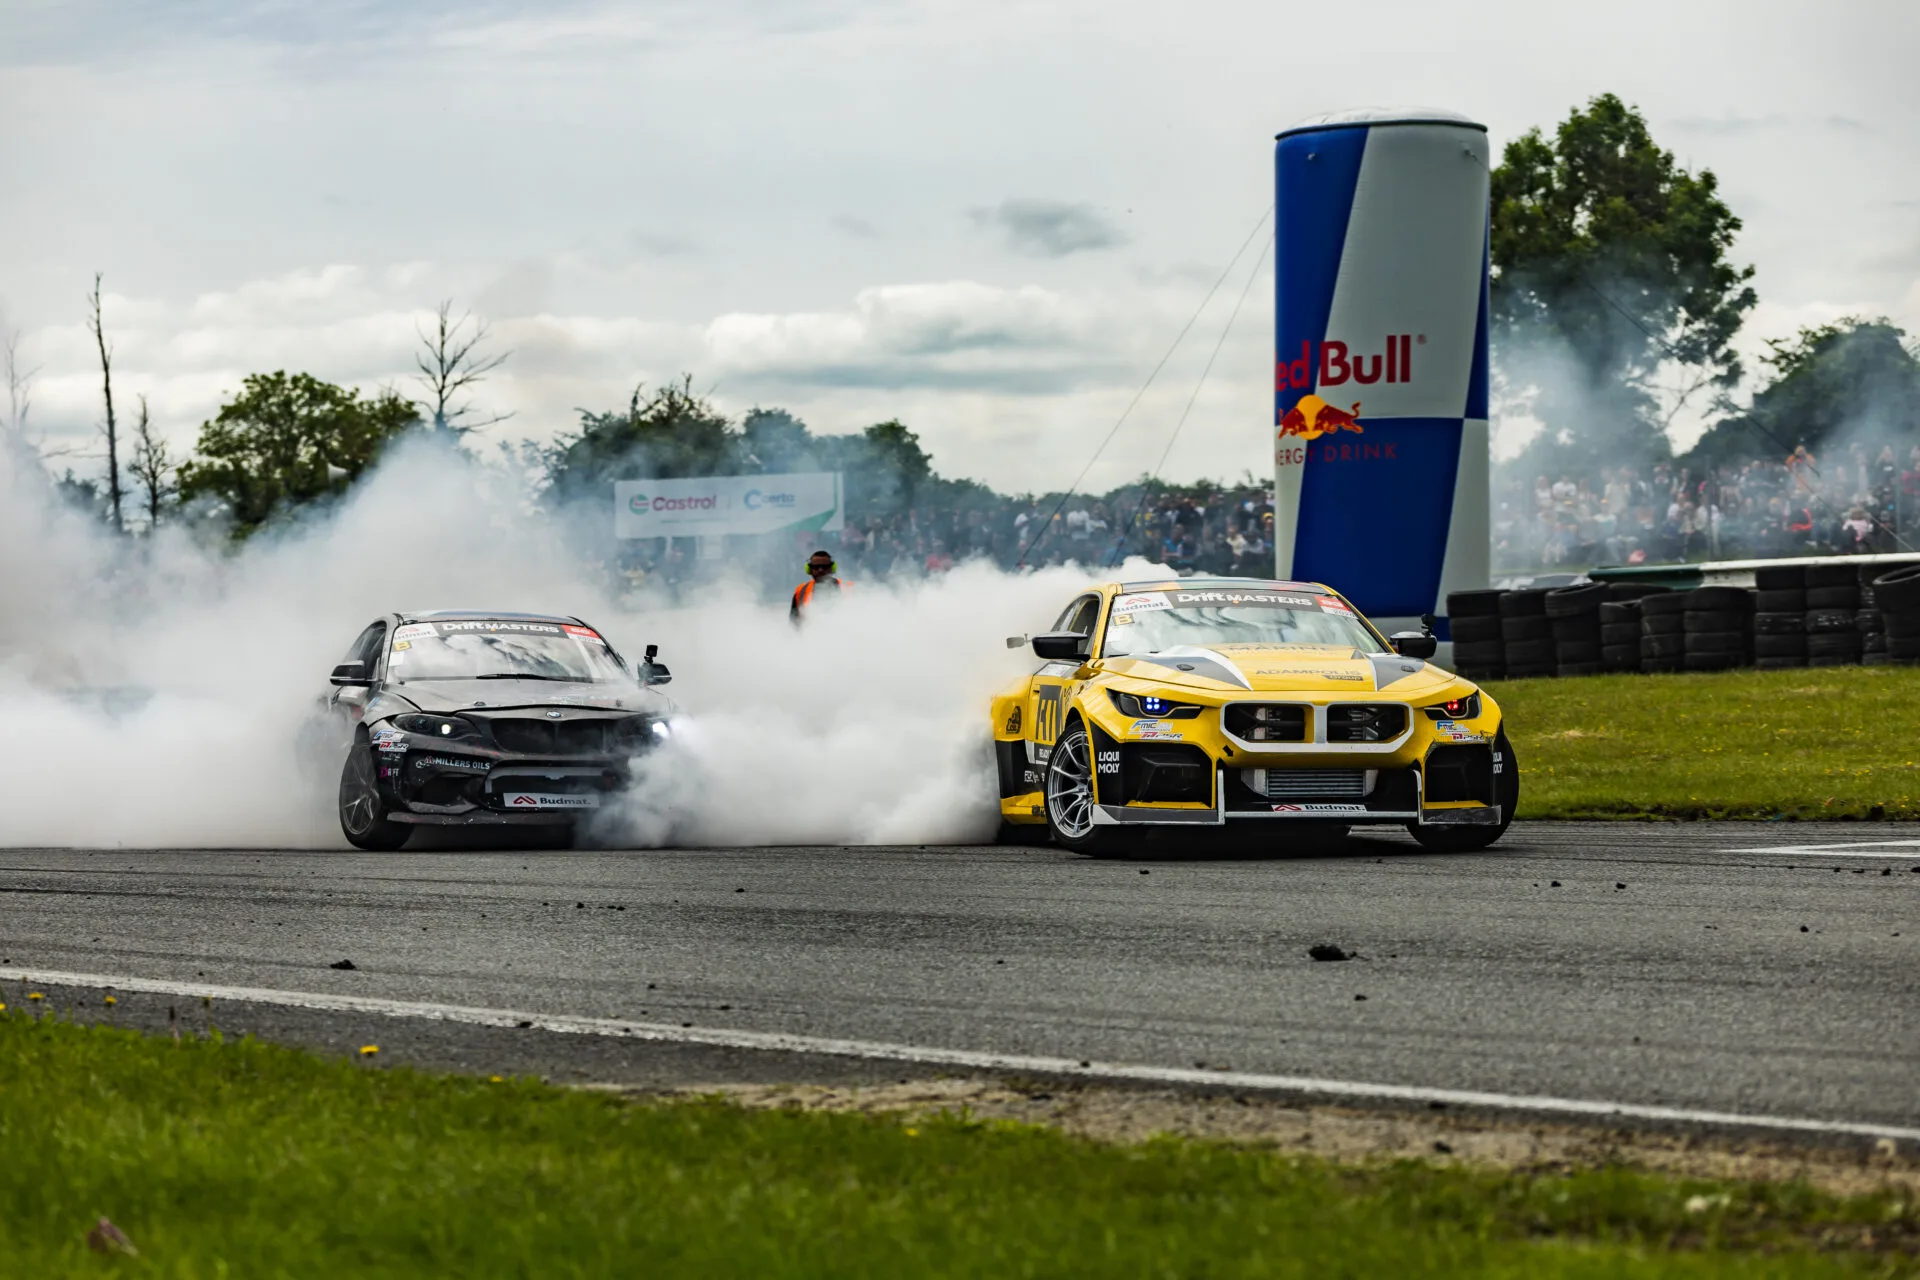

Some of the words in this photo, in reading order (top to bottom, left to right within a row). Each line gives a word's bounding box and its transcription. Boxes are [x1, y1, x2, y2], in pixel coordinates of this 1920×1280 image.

[1275, 340, 1310, 392] ed
[1319, 334, 1411, 387] Bull
[1324, 442, 1397, 462] DRINK
[652, 494, 717, 511] Castrol
[1114, 614, 1132, 626] B
[1098, 751, 1120, 762] LIQUI
[435, 758, 470, 768] MILLERS
[472, 762, 490, 770] OILS
[1097, 763, 1120, 774] MOLY
